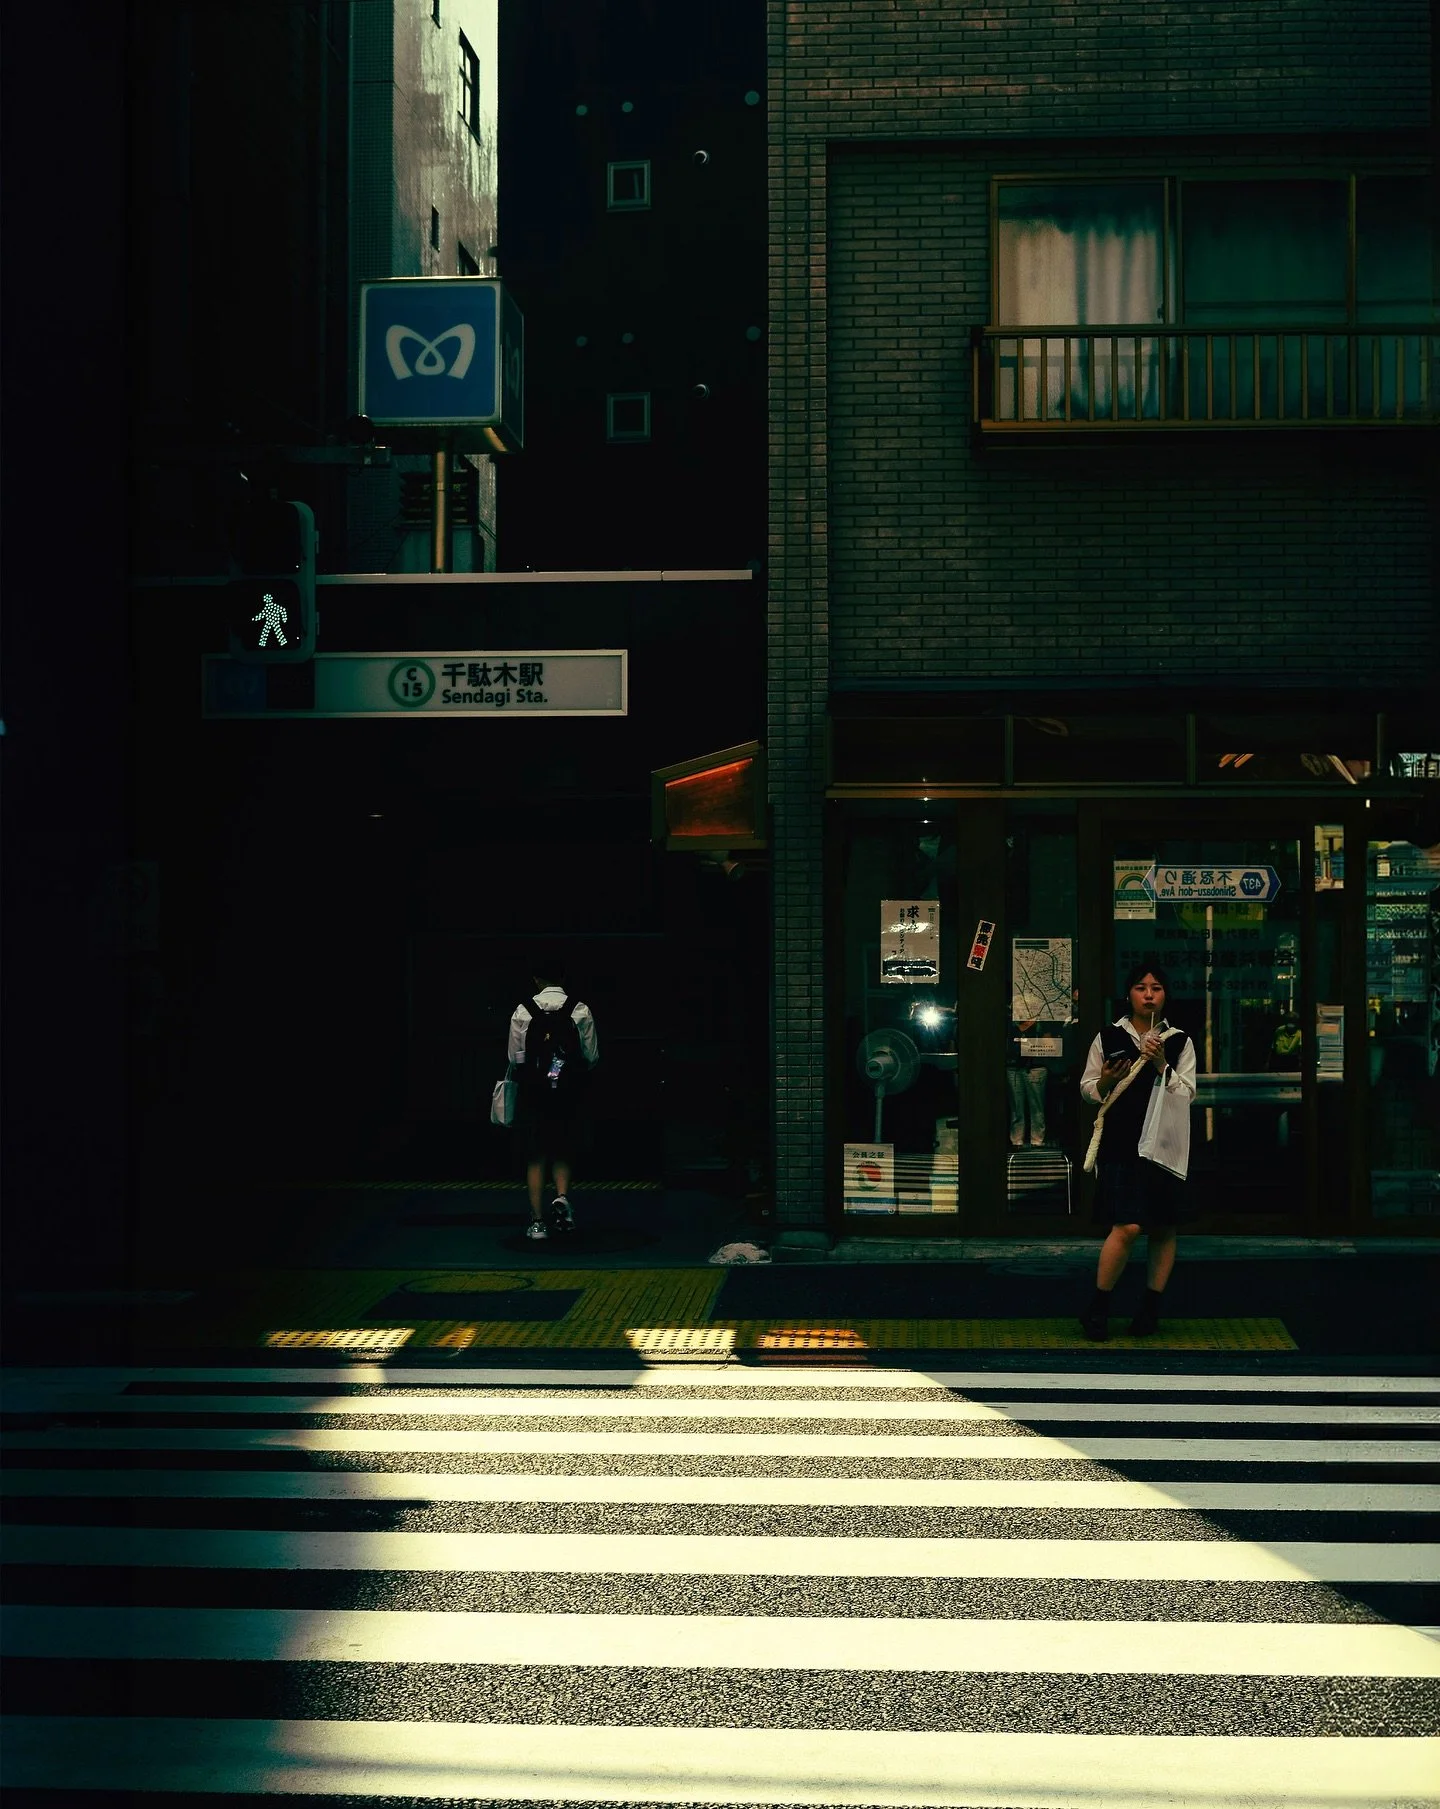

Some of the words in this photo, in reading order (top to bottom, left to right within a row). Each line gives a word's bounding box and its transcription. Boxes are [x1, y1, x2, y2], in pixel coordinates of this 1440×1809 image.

[406, 667, 417, 681] C
[442, 662, 543, 687] 千駄木駅
[402, 683, 423, 697] 15
[442, 688, 510, 707] Sendagi
[516, 689, 548, 703] Sta.
